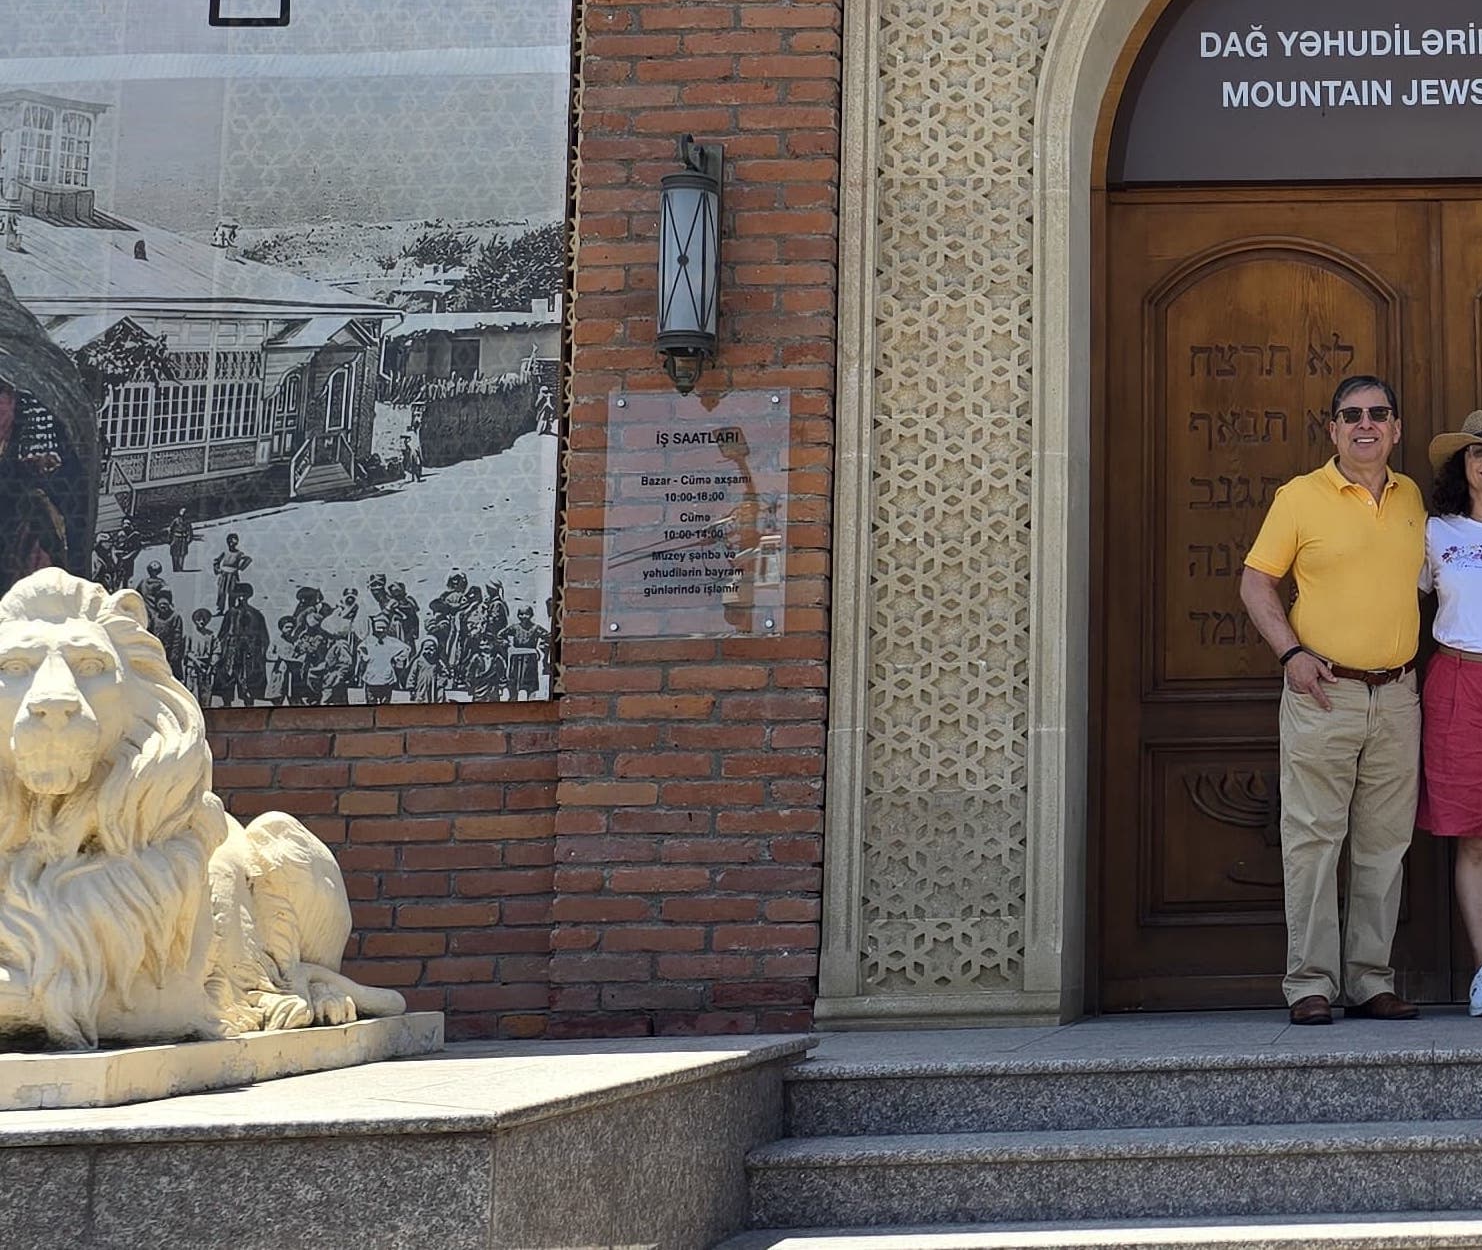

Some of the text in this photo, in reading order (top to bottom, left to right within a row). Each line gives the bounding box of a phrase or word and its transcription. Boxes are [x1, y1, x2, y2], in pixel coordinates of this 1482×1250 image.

[1200, 24, 1268, 59] DAĞ
[1221, 80, 1393, 108] MOUNTAIN
[656, 431, 740, 448] İŞ SAATLARI
[641, 476, 671, 486] Bazar
[664, 530, 724, 540] 10:00-14:00
[705, 567, 744, 578] bayram
